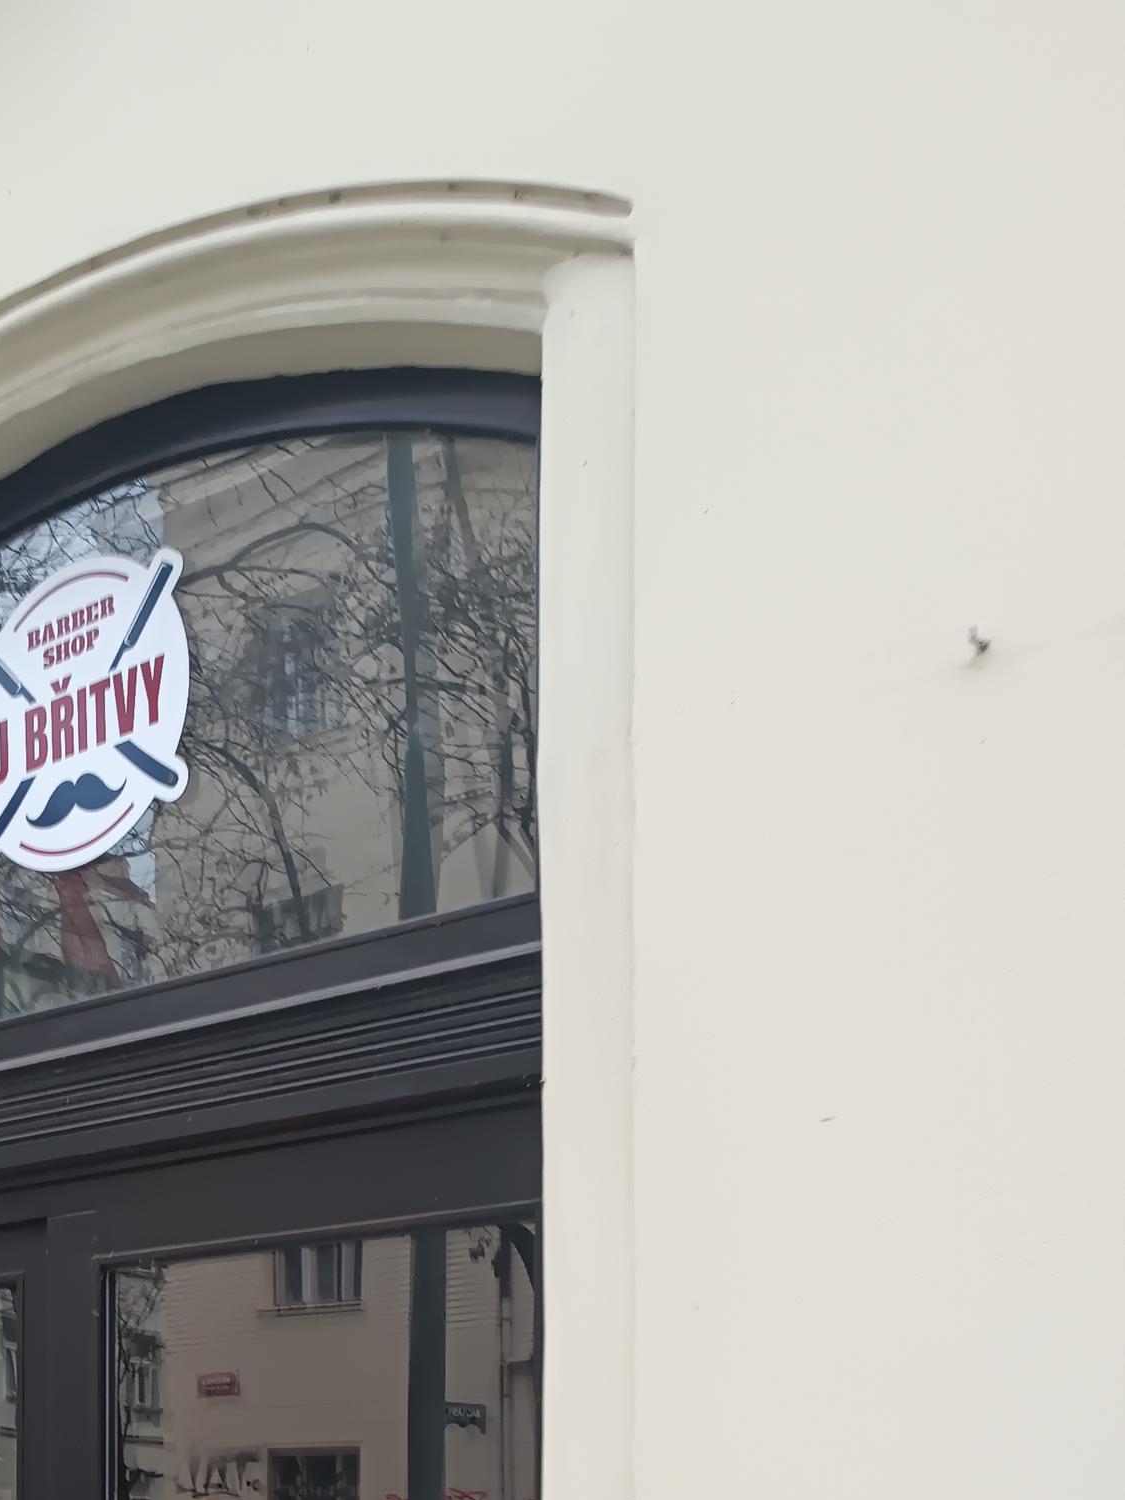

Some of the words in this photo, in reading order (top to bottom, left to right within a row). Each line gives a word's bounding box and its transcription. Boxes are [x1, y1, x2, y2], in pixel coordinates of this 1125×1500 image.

[27, 595, 115, 652] BARBER
[42, 626, 100, 670] SHOP
[25, 654, 165, 773] BŘITVY
